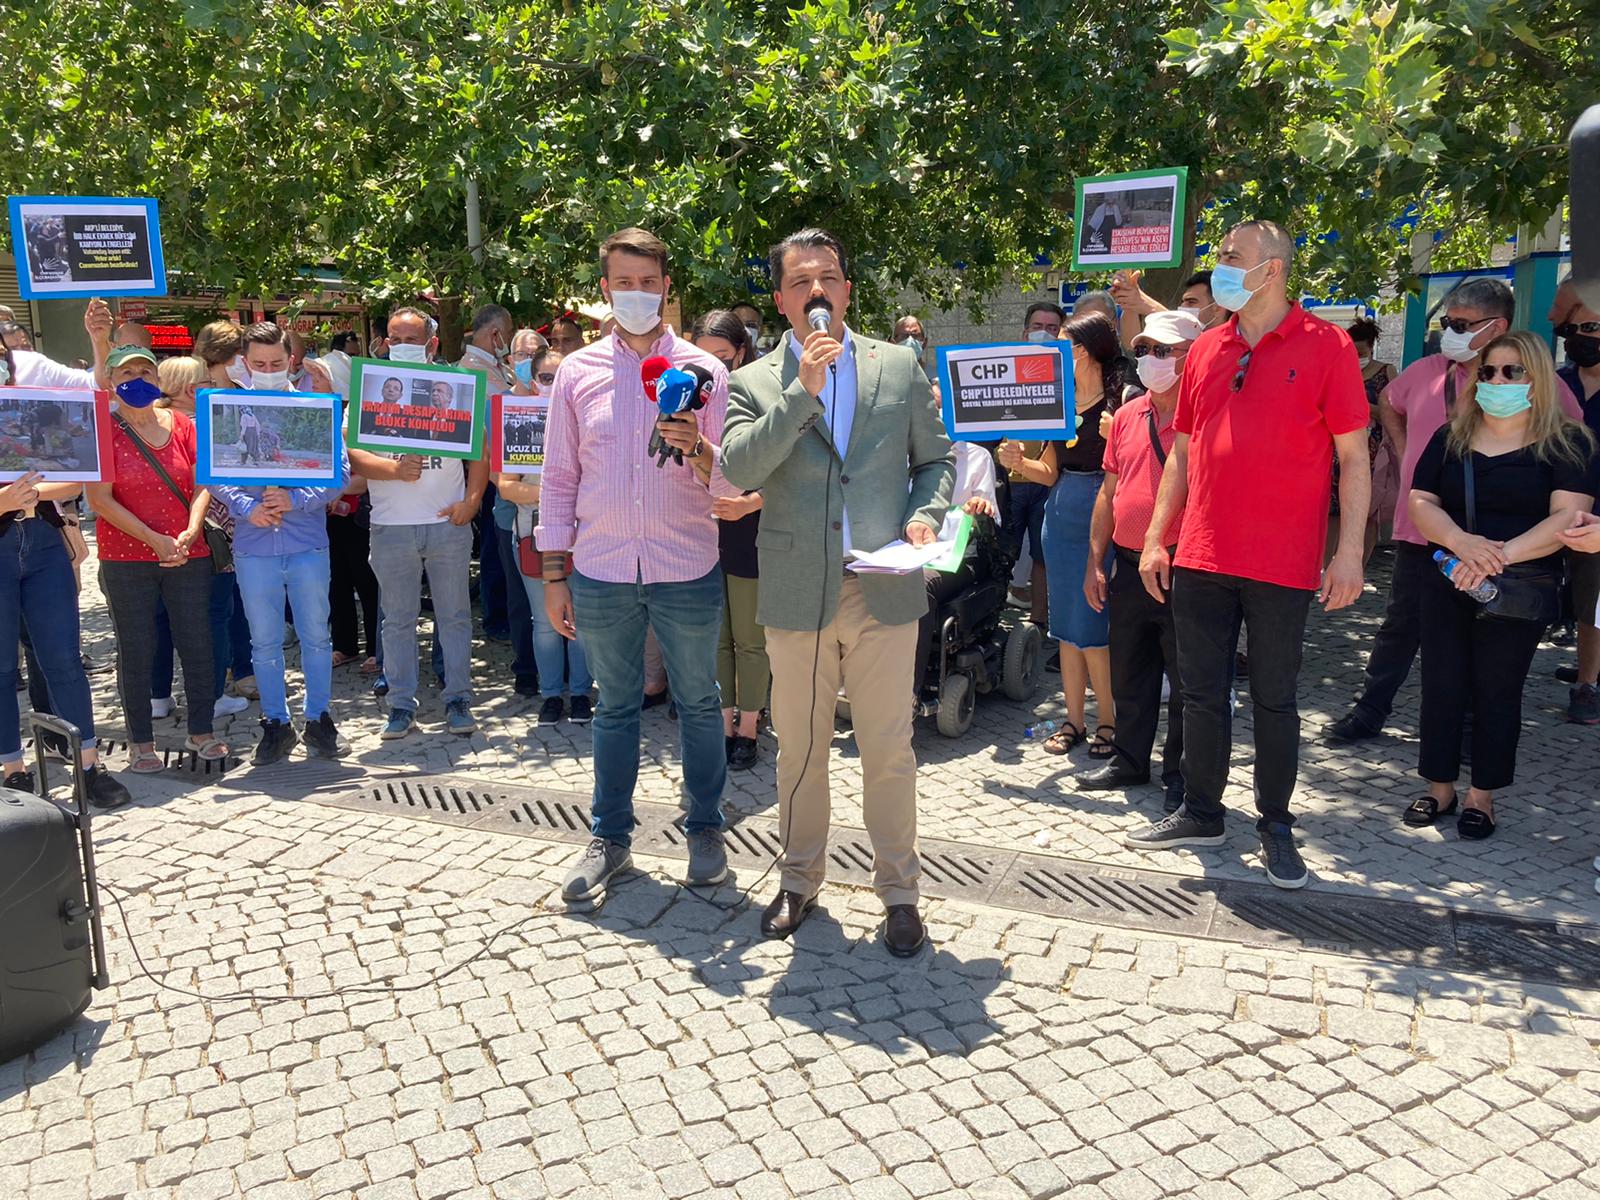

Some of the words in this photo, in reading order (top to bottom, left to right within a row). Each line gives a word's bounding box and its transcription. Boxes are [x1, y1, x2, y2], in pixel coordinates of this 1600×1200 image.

[971, 364, 1008, 380] CHP
[961, 386, 991, 400] CHP'Lİ
[993, 384, 1055, 399] BELEDİYELER
[362, 400, 400, 414] YARDIM
[402, 404, 472, 422] HESAPLARINA
[375, 415, 407, 428] BLOKE
[408, 418, 456, 433] KONULDU
[506, 445, 530, 453] UCUZ
[531, 445, 541, 453] ET
